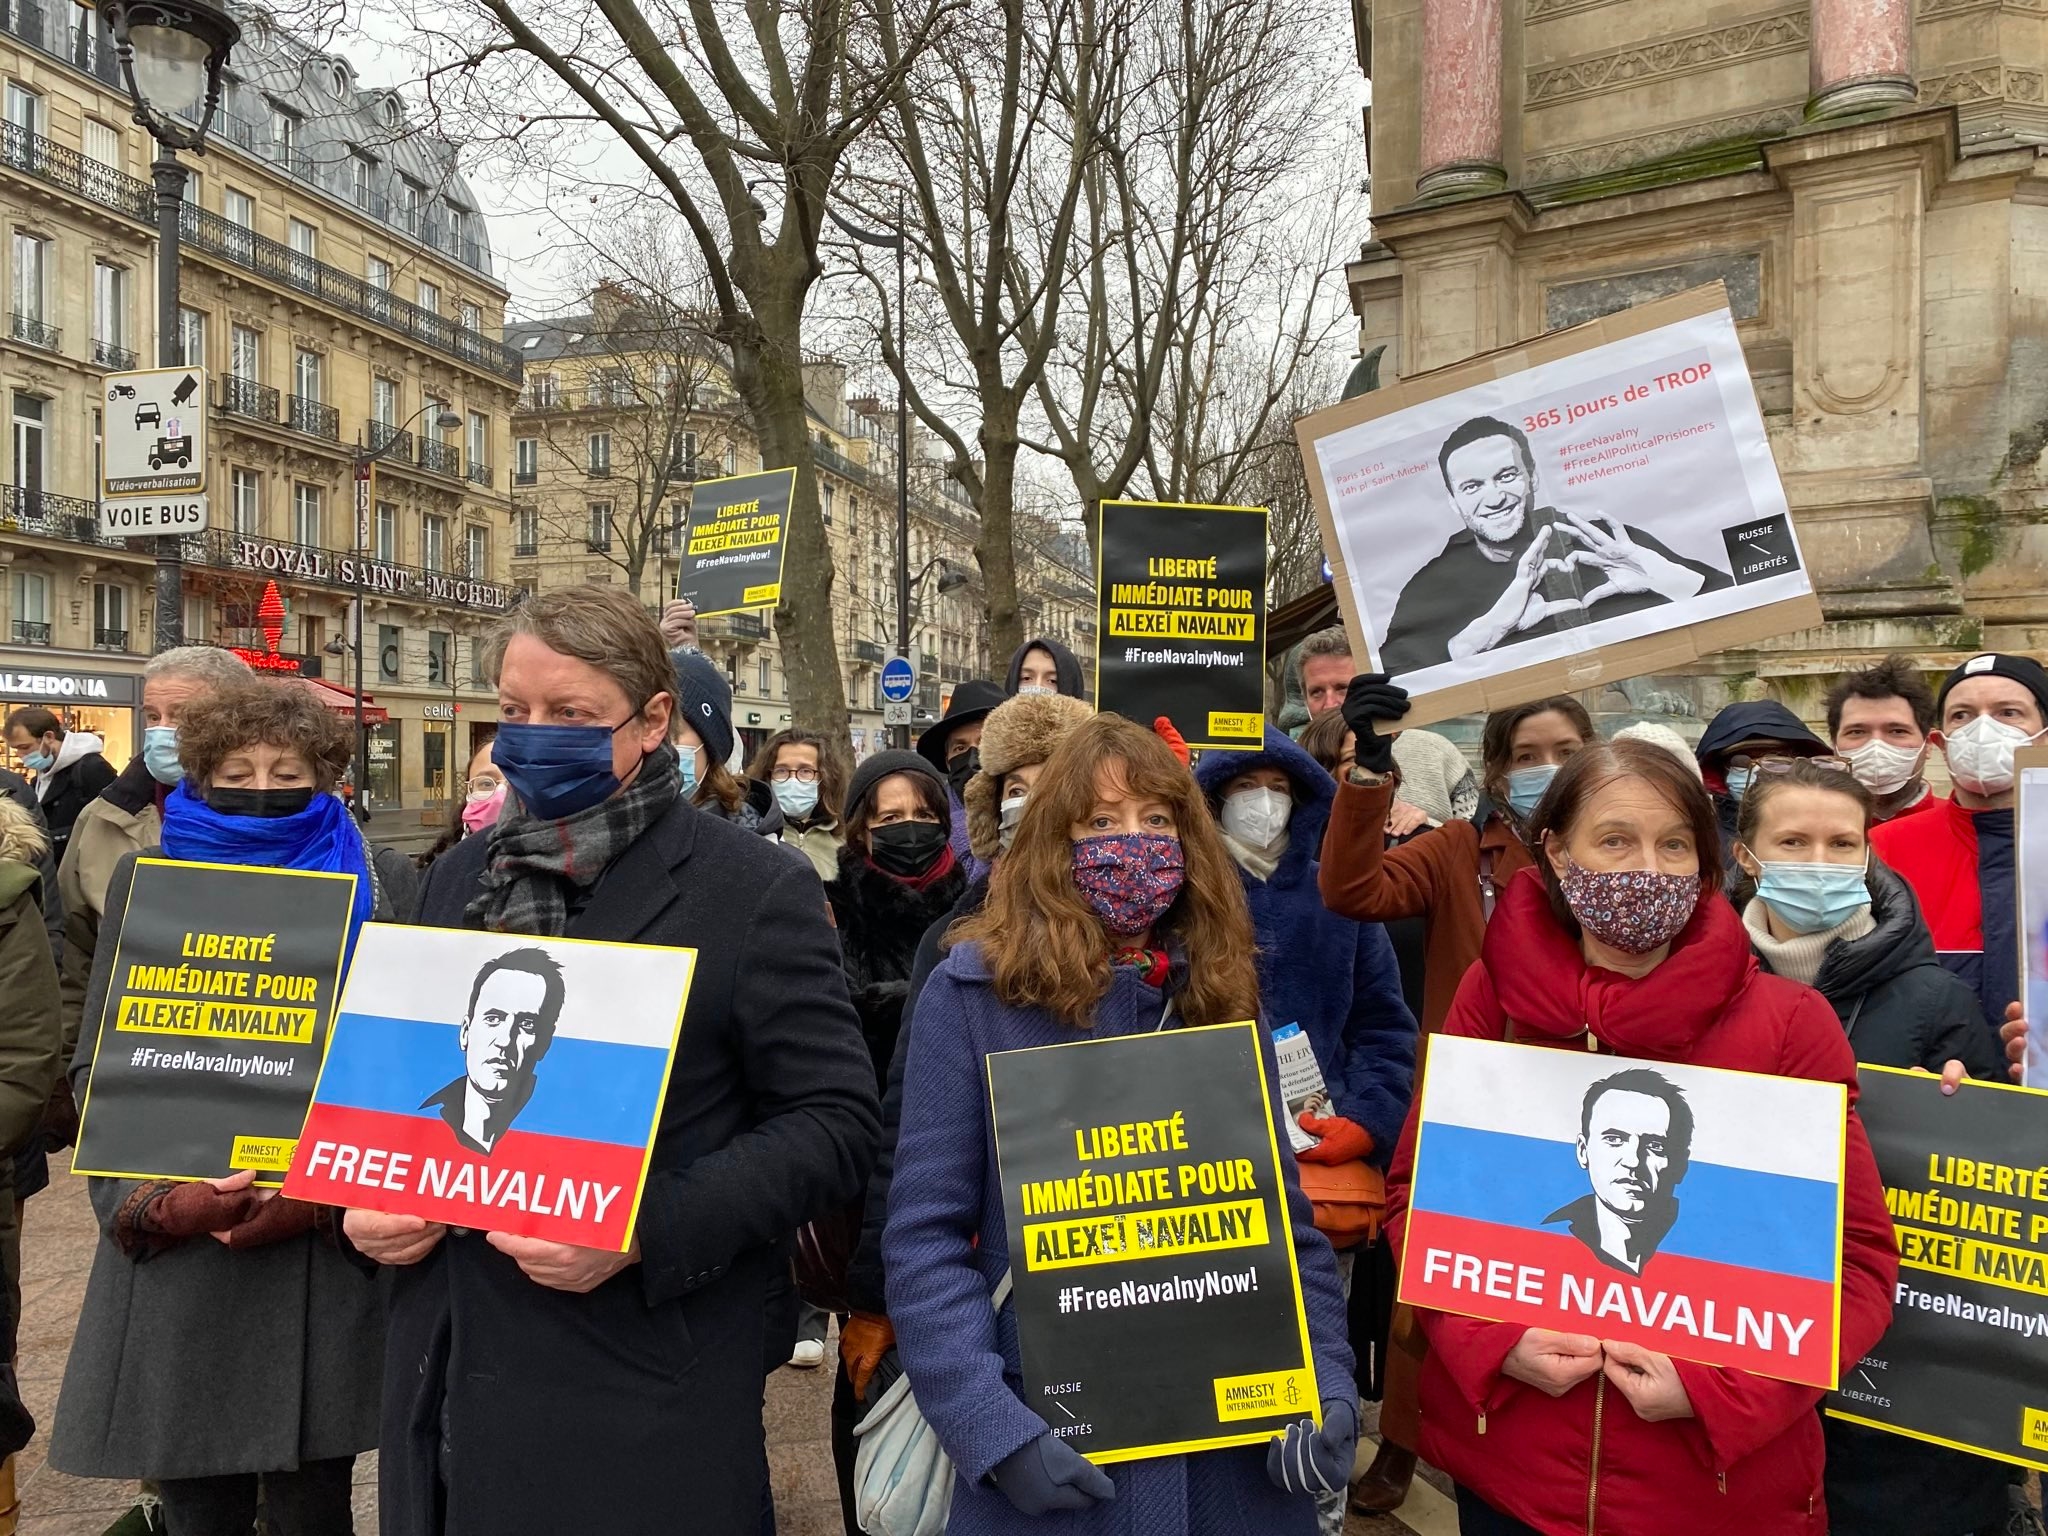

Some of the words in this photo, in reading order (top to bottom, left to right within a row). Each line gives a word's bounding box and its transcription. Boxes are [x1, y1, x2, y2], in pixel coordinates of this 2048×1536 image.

[1523, 408, 1561, 433] 365
[1566, 395, 1618, 424] jours
[1624, 385, 1650, 402] de
[1653, 362, 1712, 392] TROP
[1559, 427, 1639, 456] #FreeNavalny
[1336, 471, 1358, 485] Paris
[1340, 485, 1357, 497] 14h
[1372, 462, 1429, 487] Saint-Michel
[1567, 455, 1649, 486] #WeMemorial
[109, 477, 196, 491] Vidéo-verbalisation
[107, 507, 153, 527] VOIE
[160, 504, 200, 524] BUS
[717, 498, 759, 518] LIBERTÉ
[692, 518, 748, 537] IMMÉDIATE
[751, 513, 780, 529] POUR
[1738, 525, 1773, 541] RUSSIE
[692, 532, 728, 553] ALEXEÏ
[730, 530, 775, 546] NAVALNY
[696, 550, 770, 569] #FreeNavalnyNow!
[1149, 556, 1217, 579] LIBERTÉ
[1743, 555, 1788, 574] LIBERTÉS
[239, 541, 328, 579] ROYAL
[431, 577, 505, 608] MICHEL
[1112, 582, 1202, 607] IMMÉDIATE
[1208, 589, 1252, 609] POUR
[1115, 611, 1172, 633] ALEXEÏ
[1177, 614, 1248, 636] NAVALNY
[1125, 648, 1244, 668] #FreeNavalnyNow!
[1214, 717, 1243, 726] AMNESTY
[182, 932, 276, 962] LIBERTÉ
[126, 963, 250, 997] IMMÉDIATE
[255, 974, 318, 1002] POUR
[125, 1001, 205, 1031] ALEXEÏ
[208, 1007, 308, 1037] NAVALNY
[130, 1048, 295, 1077] #FreeNavalnyNow!
[1290, 1085, 1308, 1096] France
[1075, 1111, 1188, 1161] LIBERTÉ
[238, 1155, 279, 1164] INTERNATIONAL
[240, 1144, 281, 1156] AMNESTY
[305, 1140, 413, 1192] FREE
[418, 1157, 622, 1224] NAVALNY
[1022, 1168, 1173, 1216] IMMÉDIATE
[1180, 1158, 1256, 1195] POUR
[1928, 1153, 2048, 1202] LIBERTÉ
[1882, 1186, 2022, 1240] MMÉDIATE
[1035, 1215, 1128, 1263] ALEXEÏ
[1136, 1206, 1254, 1251] NAVALNY
[1901, 1231, 1966, 1271] EXEÏ
[1059, 1267, 1258, 1314] #FreeNavalnyNow!
[1423, 1247, 1545, 1305] FREE
[1559, 1272, 1815, 1356] NAVALNY
[1044, 1381, 1082, 1396] RUSSIE
[1225, 1383, 1275, 1401] AMNESTY
[1841, 1388, 1892, 1408] LIBERTÉS
[1226, 1398, 1278, 1412] INTERNATIONAL
[1050, 1422, 1093, 1438] IBERTÉS
